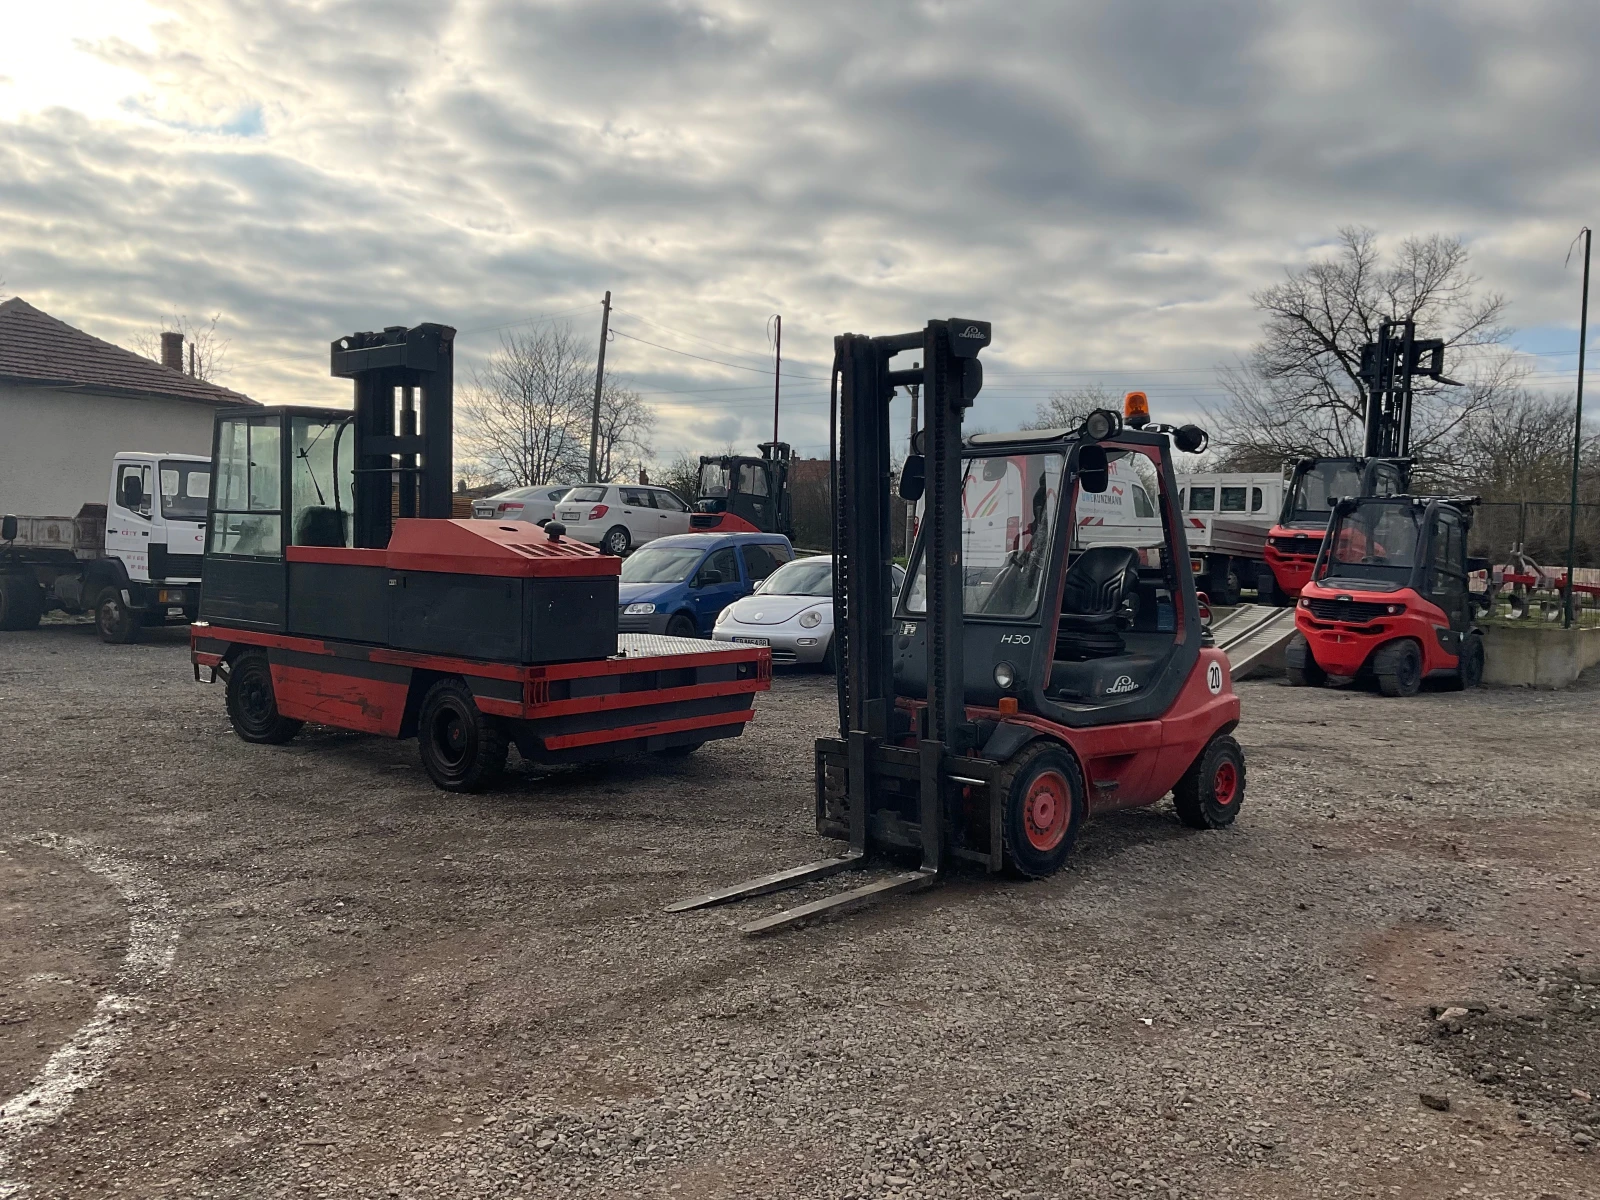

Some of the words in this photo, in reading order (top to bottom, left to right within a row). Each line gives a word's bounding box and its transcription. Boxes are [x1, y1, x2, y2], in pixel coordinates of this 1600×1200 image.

[958, 325, 986, 339] Linde
[1000, 634, 1031, 645] H30
[1106, 675, 1139, 693] Linde
[1210, 666, 1220, 689] 20
